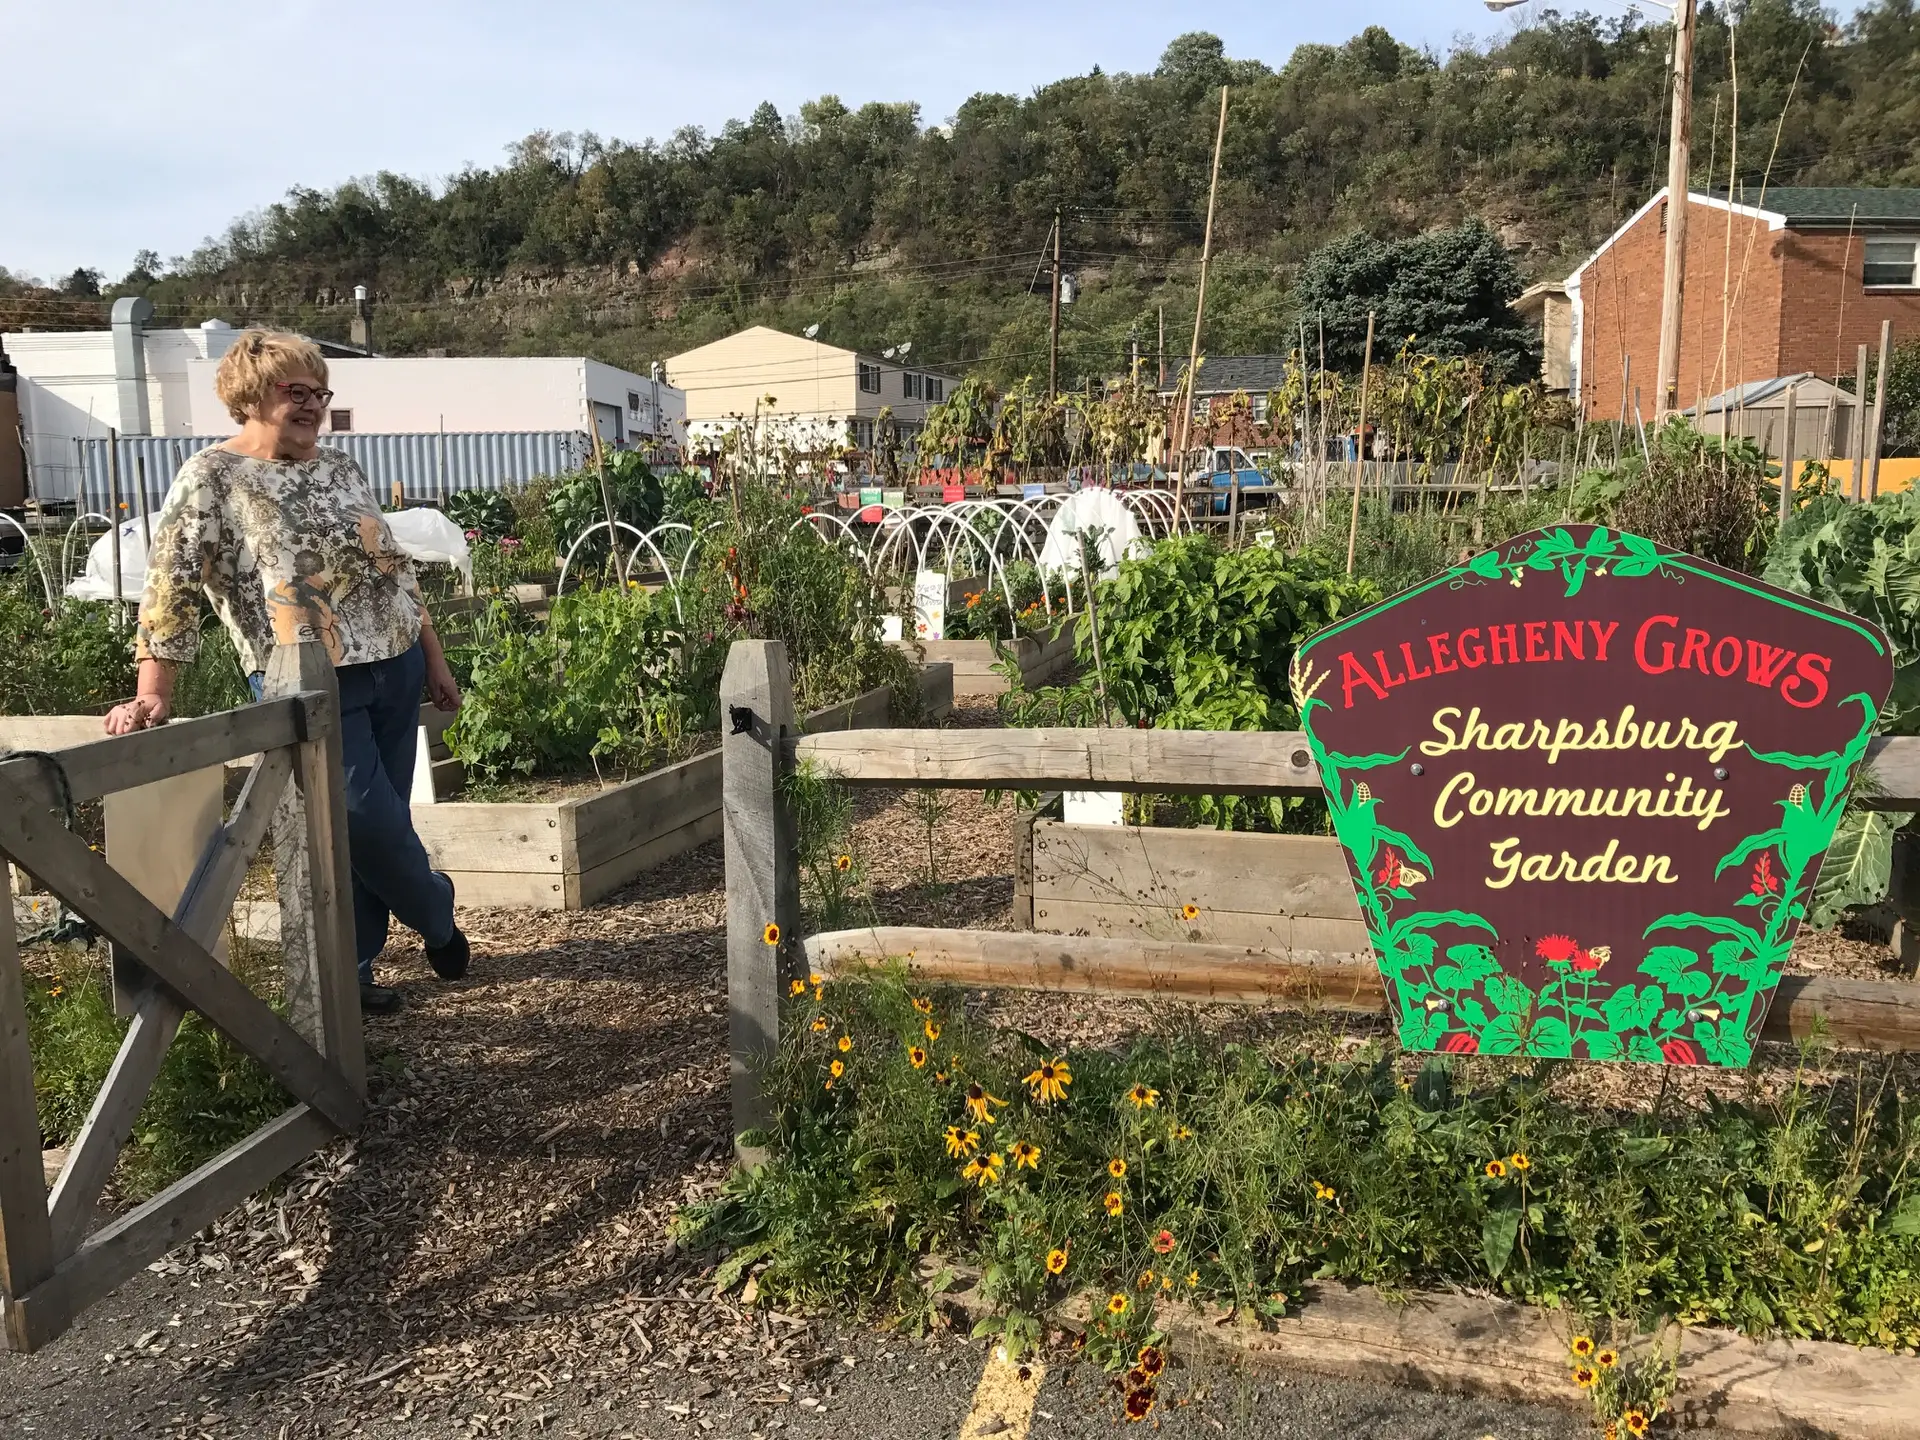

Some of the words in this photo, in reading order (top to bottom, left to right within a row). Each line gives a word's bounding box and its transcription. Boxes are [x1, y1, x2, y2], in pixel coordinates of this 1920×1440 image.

[1338, 619, 1619, 709] ALLEGHENY
[1634, 614, 1832, 708] GROWS
[1419, 705, 1744, 764] Sharpsburg
[1433, 772, 1730, 831] Community
[1485, 839, 1679, 889] Garden
